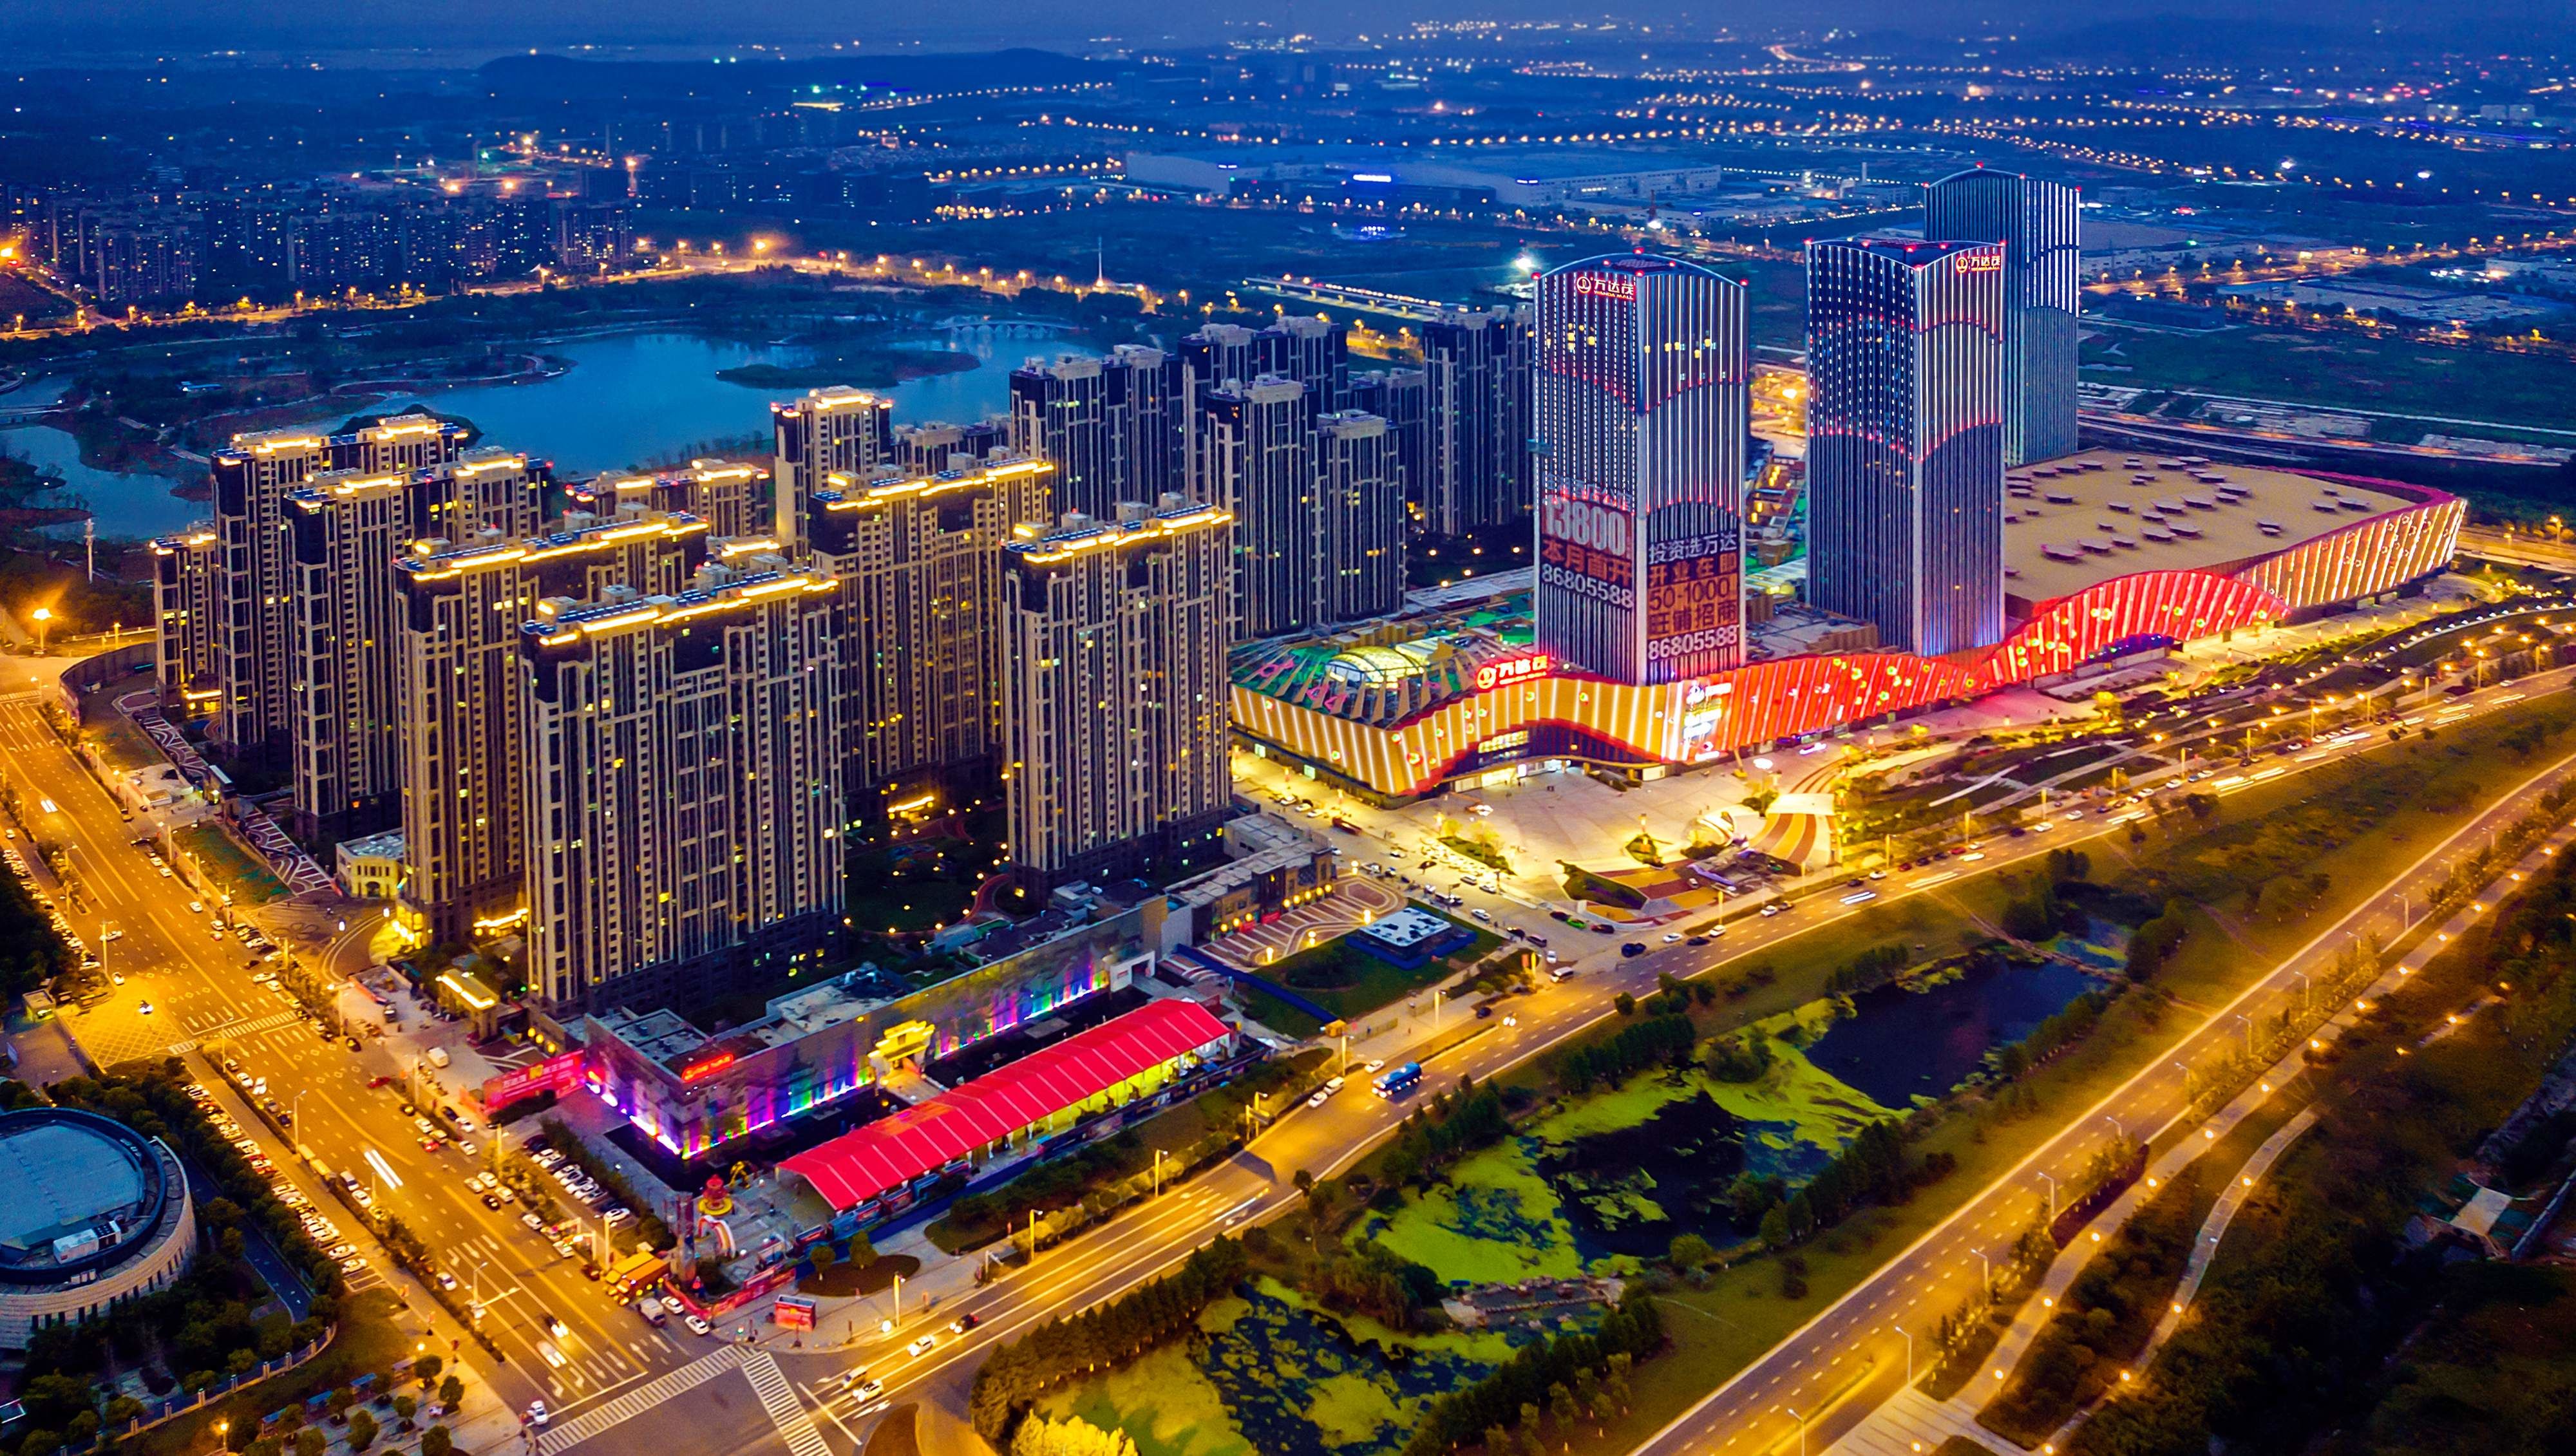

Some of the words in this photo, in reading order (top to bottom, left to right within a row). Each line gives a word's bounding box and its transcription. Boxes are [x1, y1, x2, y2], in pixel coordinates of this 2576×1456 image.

[1971, 256, 2000, 267] 万达茂
[1594, 278, 1634, 296] 万达茂
[1545, 494, 1626, 556] 13800
[1542, 539, 1633, 587] 本月首开
[1648, 531, 1738, 565] 投资选万达
[1541, 563, 1634, 608] 86805588
[1649, 552, 1737, 587] 开业在即
[1649, 577, 1730, 610] 50-1000
[1649, 600, 1738, 635] 旺铺招商
[1648, 625, 1738, 660] 86805588
